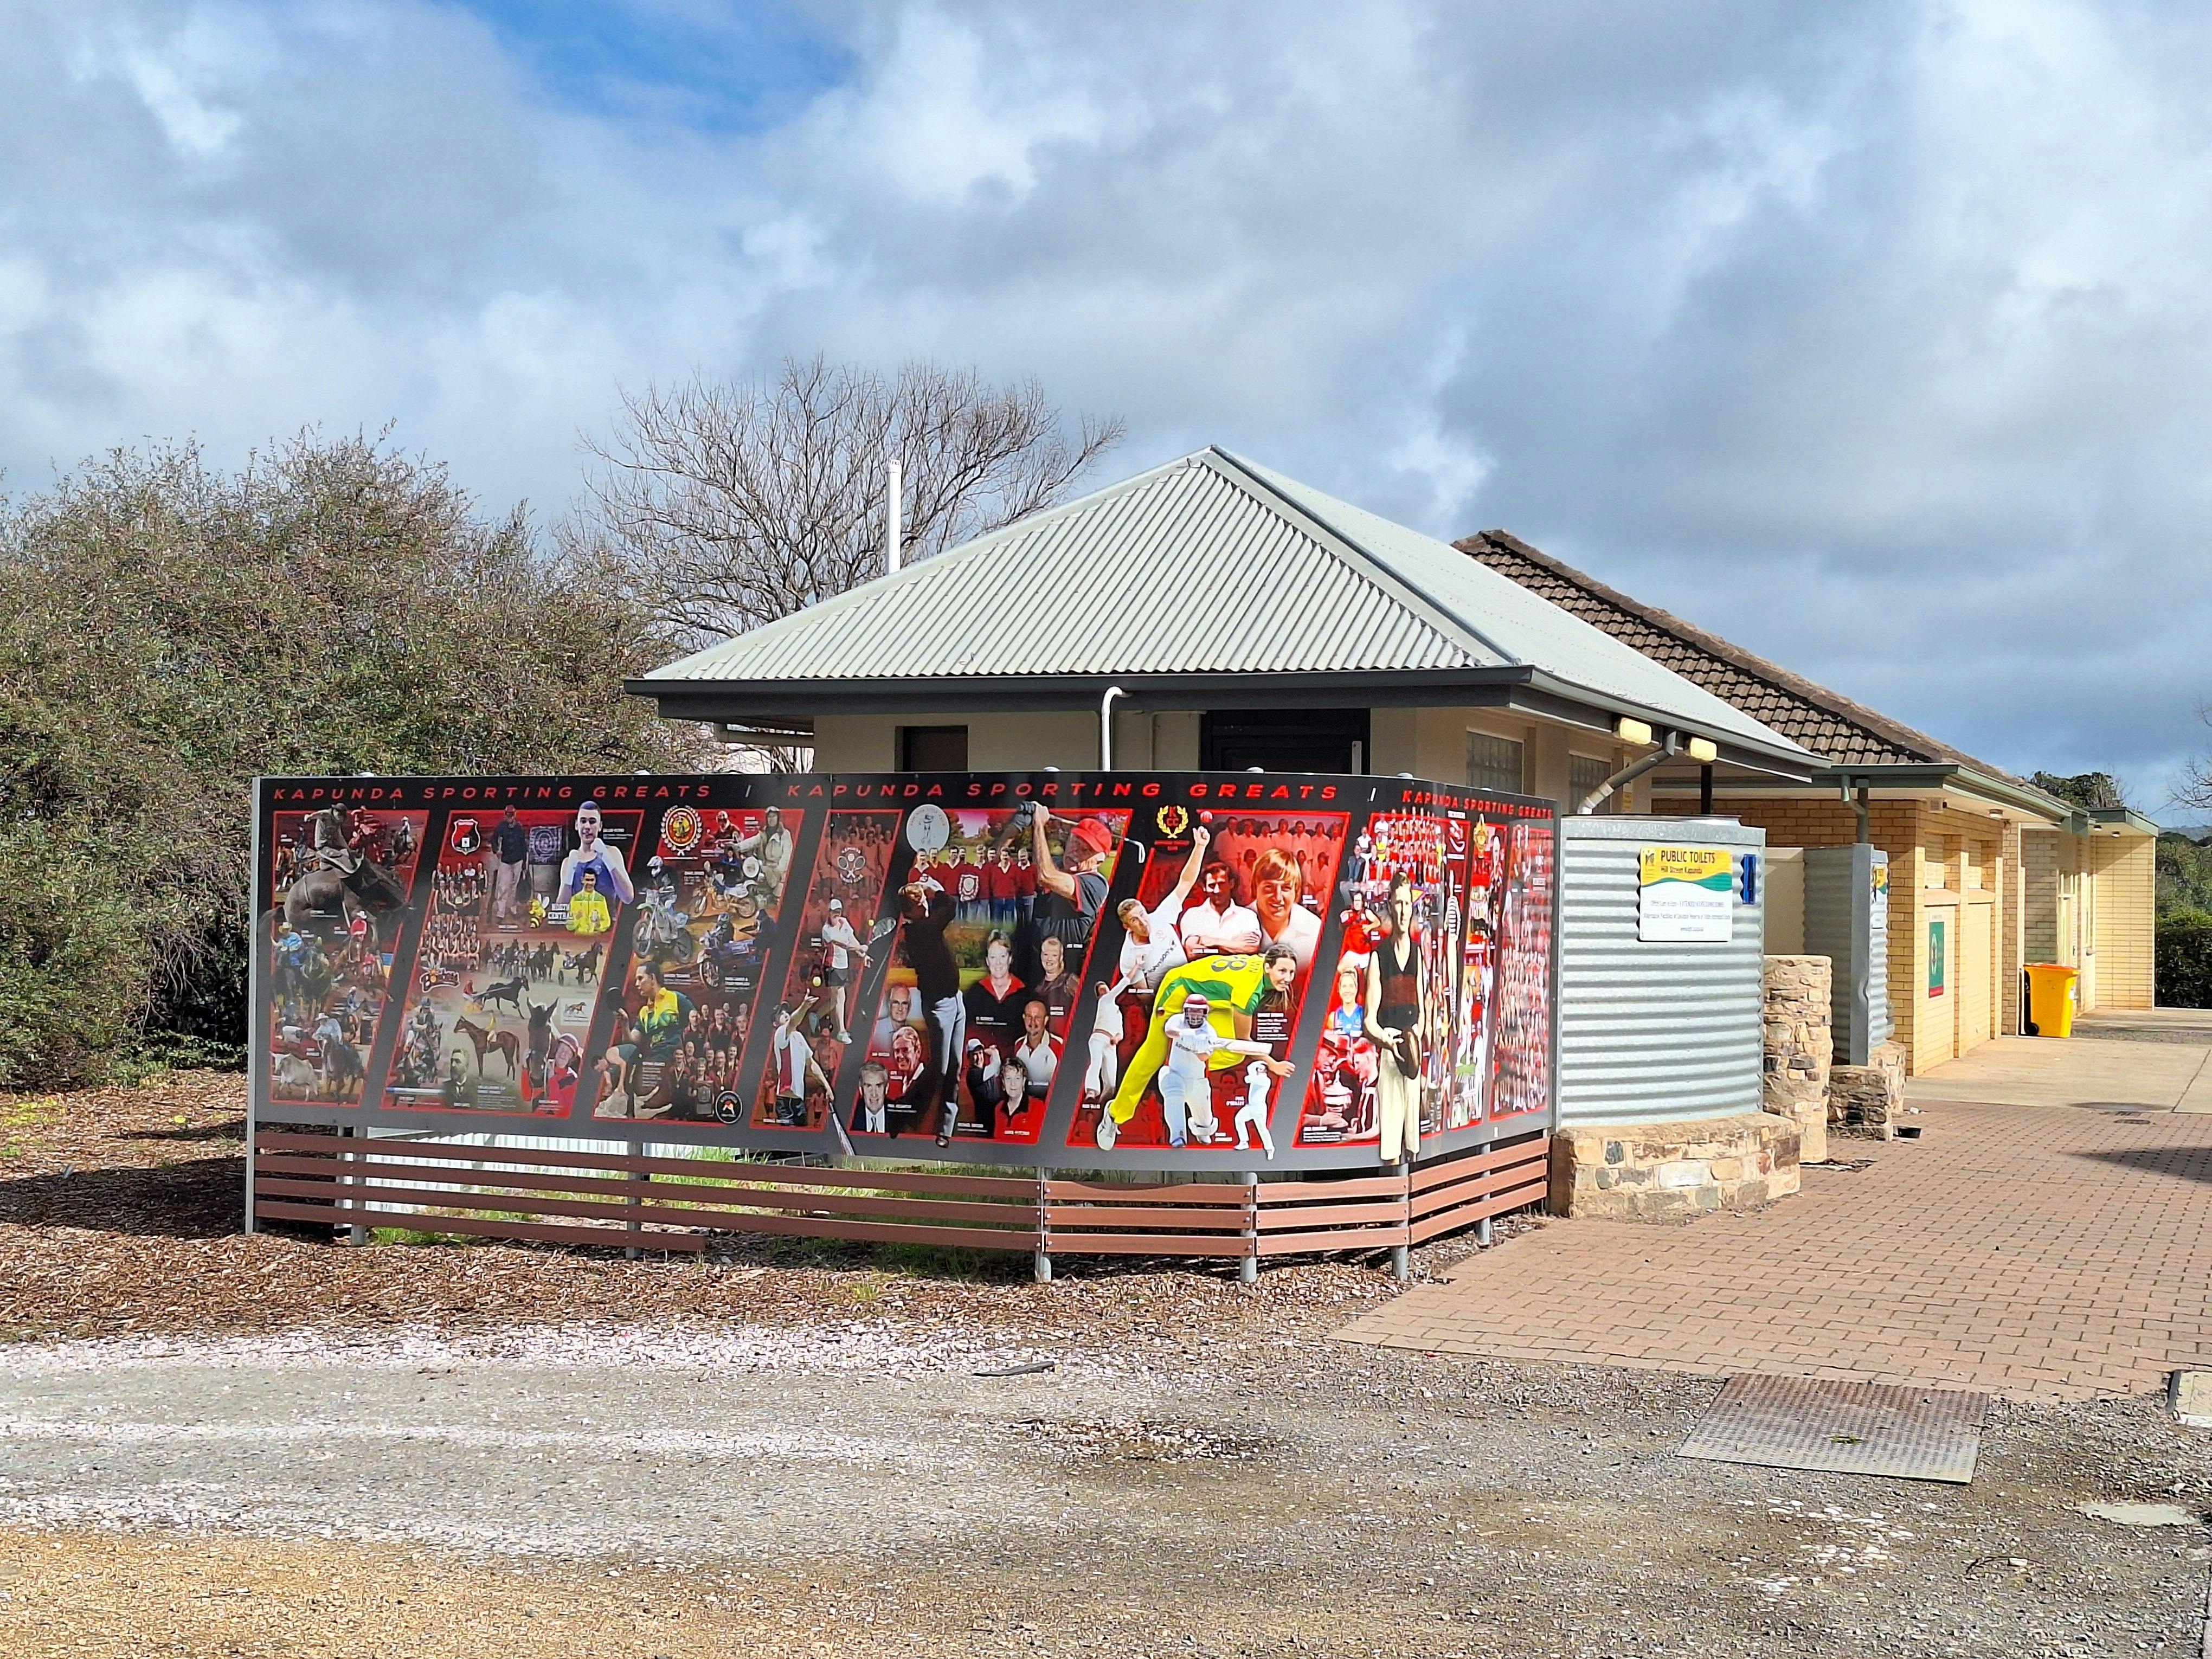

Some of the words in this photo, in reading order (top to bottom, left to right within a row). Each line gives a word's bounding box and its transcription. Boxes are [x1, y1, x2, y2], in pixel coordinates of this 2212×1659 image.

[273, 787, 403, 800] KAPUNDA
[423, 786, 573, 799] SPORTING
[593, 785, 711, 798] GREATS
[787, 784, 943, 797] KAPUNDA
[967, 782, 1161, 798] SPORTING
[1189, 783, 1337, 800] GREATS
[1402, 790, 1459, 808] KAPUNDA
[1464, 798, 1515, 815] SPORTING
[1518, 805, 1553, 820] GREATS
[1661, 850, 1687, 863] PUBLIC
[1689, 851, 1715, 864] TOILETS
